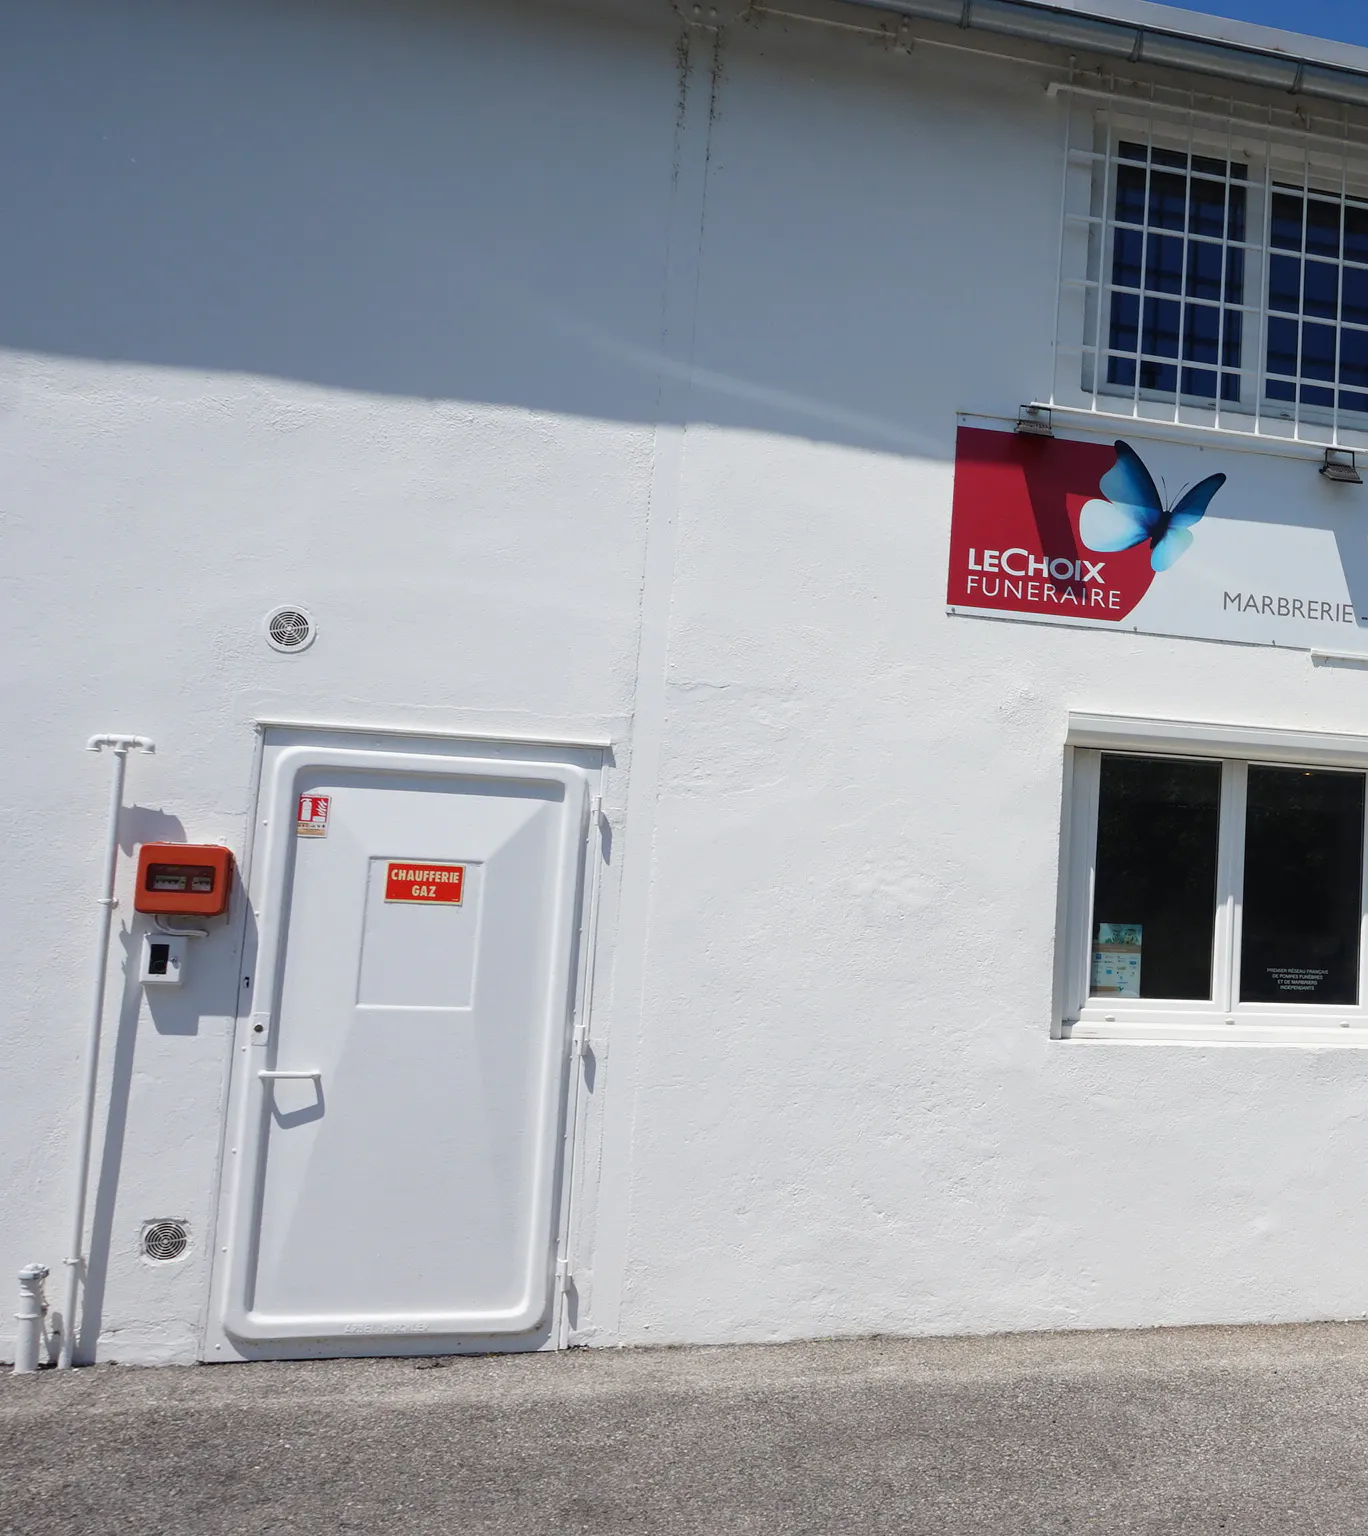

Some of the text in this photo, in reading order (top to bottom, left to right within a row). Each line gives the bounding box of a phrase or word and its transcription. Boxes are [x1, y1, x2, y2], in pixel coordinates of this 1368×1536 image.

[966, 575, 1121, 610] FUNERAIRE
[1223, 590, 1354, 624] MARBRERIE
[391, 869, 460, 883] CHAUFFERIE
[411, 885, 437, 897] GAZ
